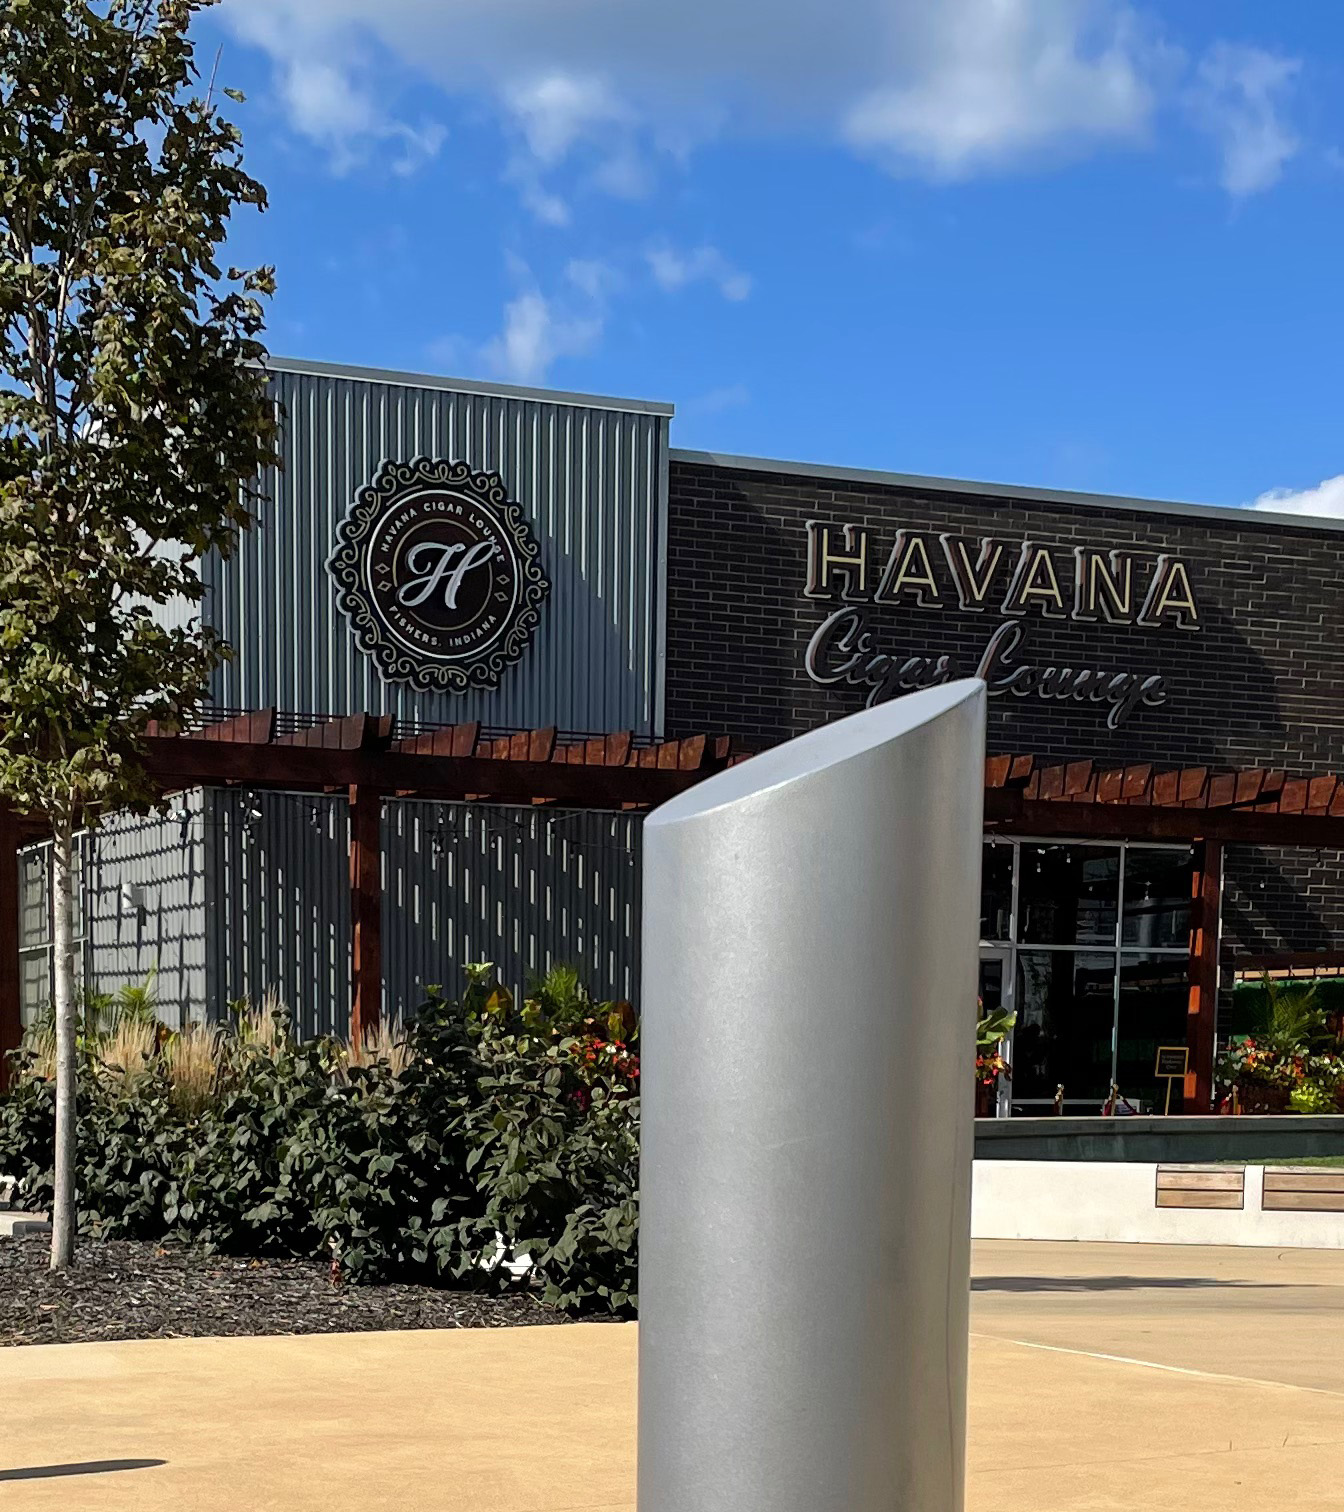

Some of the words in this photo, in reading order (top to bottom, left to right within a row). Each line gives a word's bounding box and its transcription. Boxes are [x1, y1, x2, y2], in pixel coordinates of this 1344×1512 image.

[381, 508, 418, 553] HAVANA
[423, 501, 463, 516] CIGAR
[803, 519, 1201, 632] HAVANA
[448, 614, 497, 648] INDIANA
[805, 605, 958, 710] Cigar
[973, 619, 1169, 730] Lounge
